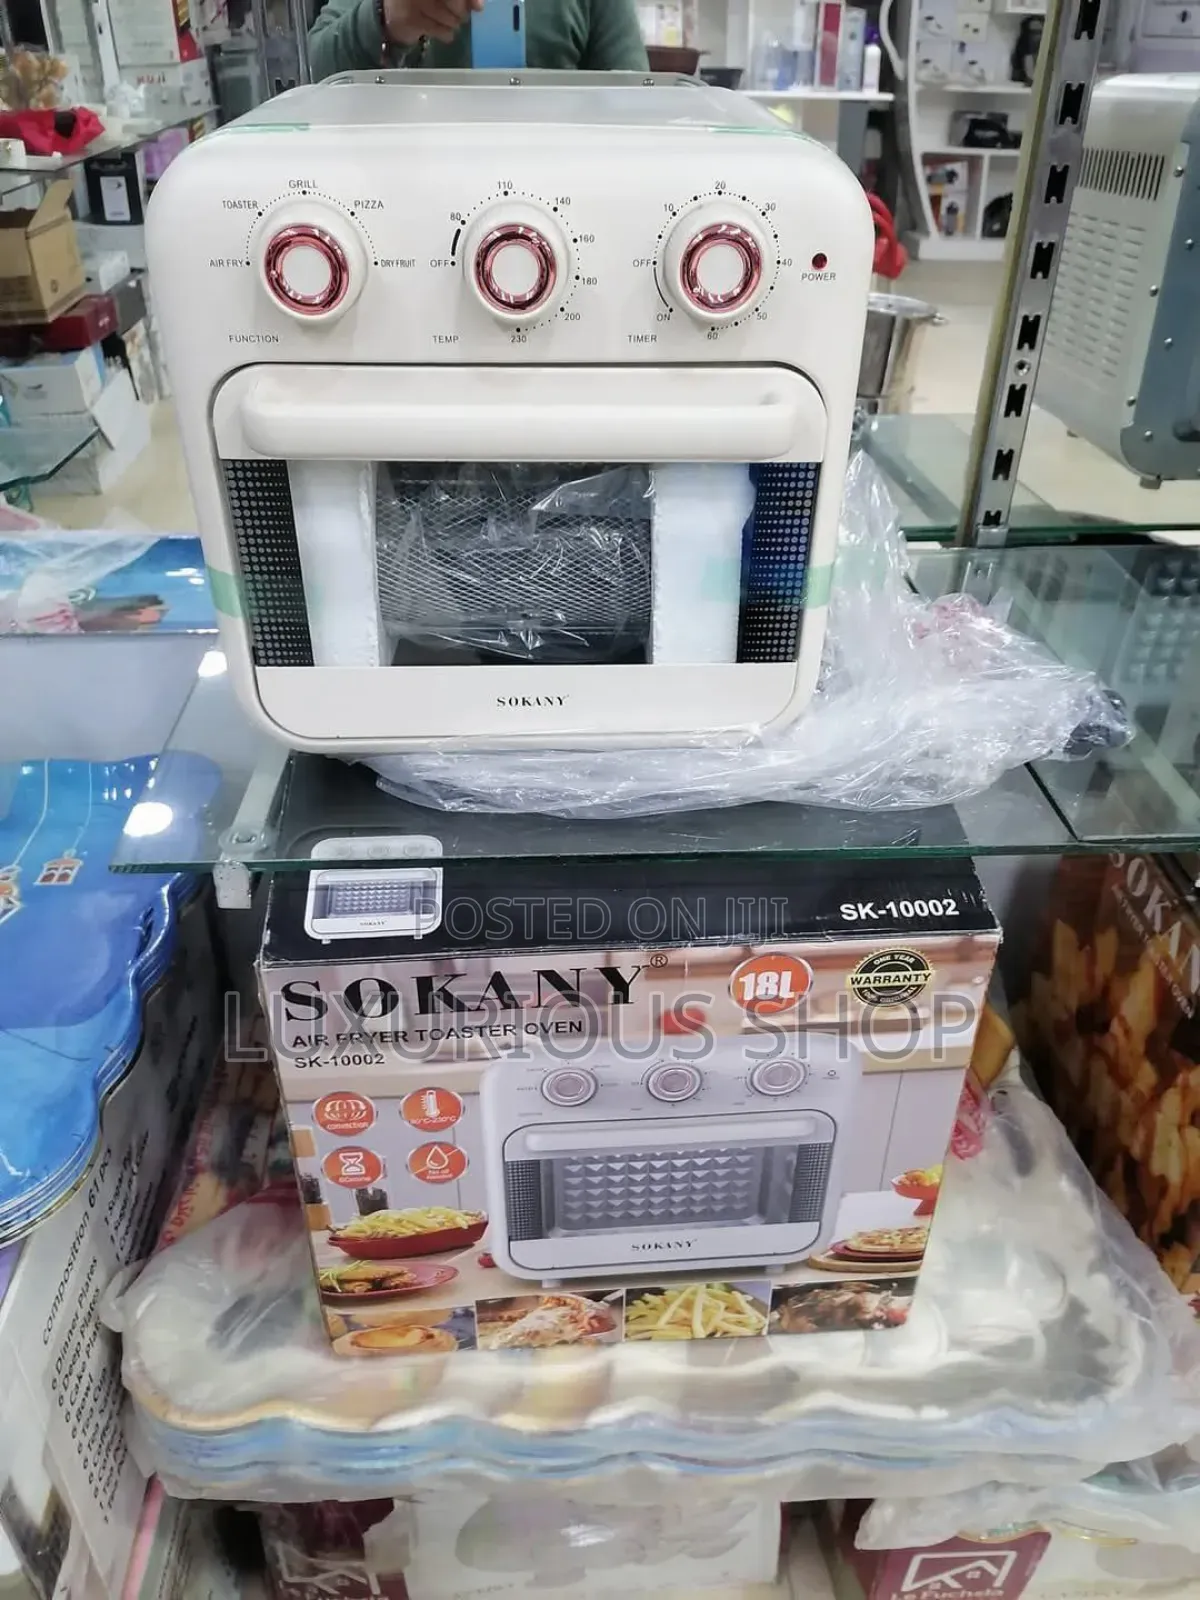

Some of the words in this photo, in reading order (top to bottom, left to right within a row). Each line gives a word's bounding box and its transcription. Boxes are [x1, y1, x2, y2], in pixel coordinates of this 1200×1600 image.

[288, 179, 319, 189] GRILL
[497, 181, 513, 190] 110
[714, 181, 726, 190] 20
[222, 200, 259, 210] TOASTER
[354, 200, 385, 210] PIZZA
[555, 196, 571, 206] 140
[663, 203, 675, 212] 10
[764, 203, 777, 212] 30
[450, 212, 462, 222] 80
[578, 234, 596, 243] 160
[209, 258, 226, 268] AIR
[226, 258, 244, 268] FRY
[380, 258, 396, 268] DRY
[396, 258, 416, 268] FRUIT
[429, 259, 450, 268] OFF
[632, 259, 652, 268] OFF
[781, 258, 793, 268] 40
[581, 277, 598, 286] 180
[800, 272, 837, 282] POWER
[564, 312, 581, 322] 200
[656, 313, 671, 322] ON
[756, 312, 768, 322] 50
[228, 334, 280, 344] FUNCTION
[432, 335, 460, 344] TEMP
[510, 335, 528, 344] 230
[627, 334, 658, 344] TIMER
[706, 332, 719, 341] 60
[496, 695, 567, 707] SOKANY
[839, 898, 960, 922] SK-10002
[892, 953, 916, 964] YEAR
[850, 972, 933, 986] WARRANTY
[739, 970, 796, 1002] 18L
[292, 1034, 330, 1049] AIR
[336, 1030, 409, 1046] FRYER
[415, 1024, 517, 1044] TOASTER
[524, 1020, 583, 1036] OVEN
[294, 1053, 386, 1069] SK-10002
[43, 1211, 90, 1345] composition
[88, 1178, 100, 1209] 61
[99, 1146, 113, 1183] pcs
[55, 1311, 80, 1376] Dinner
[77, 1256, 98, 1309] Plates
[62, 1342, 82, 1392] Deep
[80, 1288, 101, 1338] Plates
[69, 1360, 87, 1407] Cake
[76, 1372, 94, 1423] Bowl
